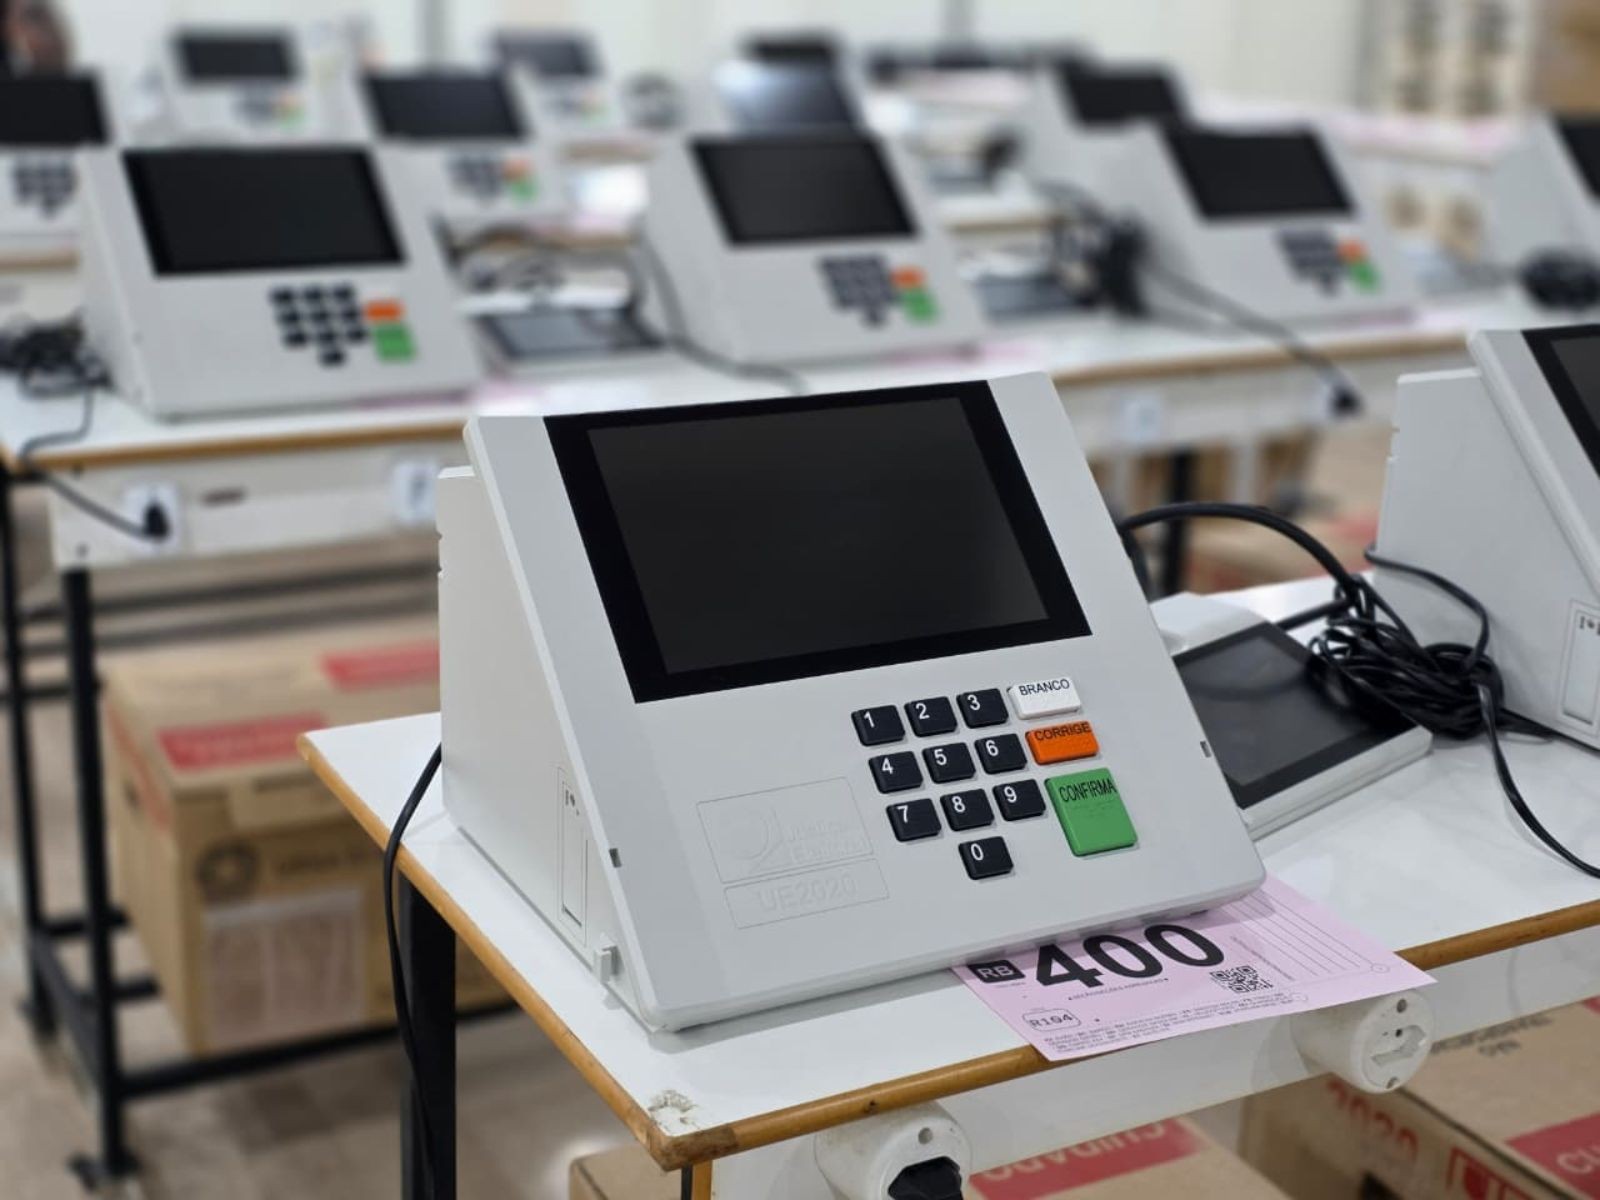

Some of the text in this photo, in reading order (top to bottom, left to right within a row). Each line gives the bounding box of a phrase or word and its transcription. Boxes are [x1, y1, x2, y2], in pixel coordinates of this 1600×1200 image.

[1018, 678, 1071, 697] BRANCO
[915, 702, 930, 720] 2
[967, 693, 981, 711] 3
[863, 712, 876, 729] 1
[1034, 721, 1092, 742] CORRIGE
[934, 748, 947, 766] 5
[985, 739, 999, 757] 6
[881, 757, 895, 775] 4
[1003, 785, 1017, 804] 9
[1058, 777, 1118, 803] CONFIRMA
[951, 795, 966, 813] 8
[897, 804, 910, 823] 7
[970, 842, 985, 862] 0
[756, 872, 858, 912] UE2020
[1036, 924, 1225, 989] 400
[977, 965, 1014, 979] RB
